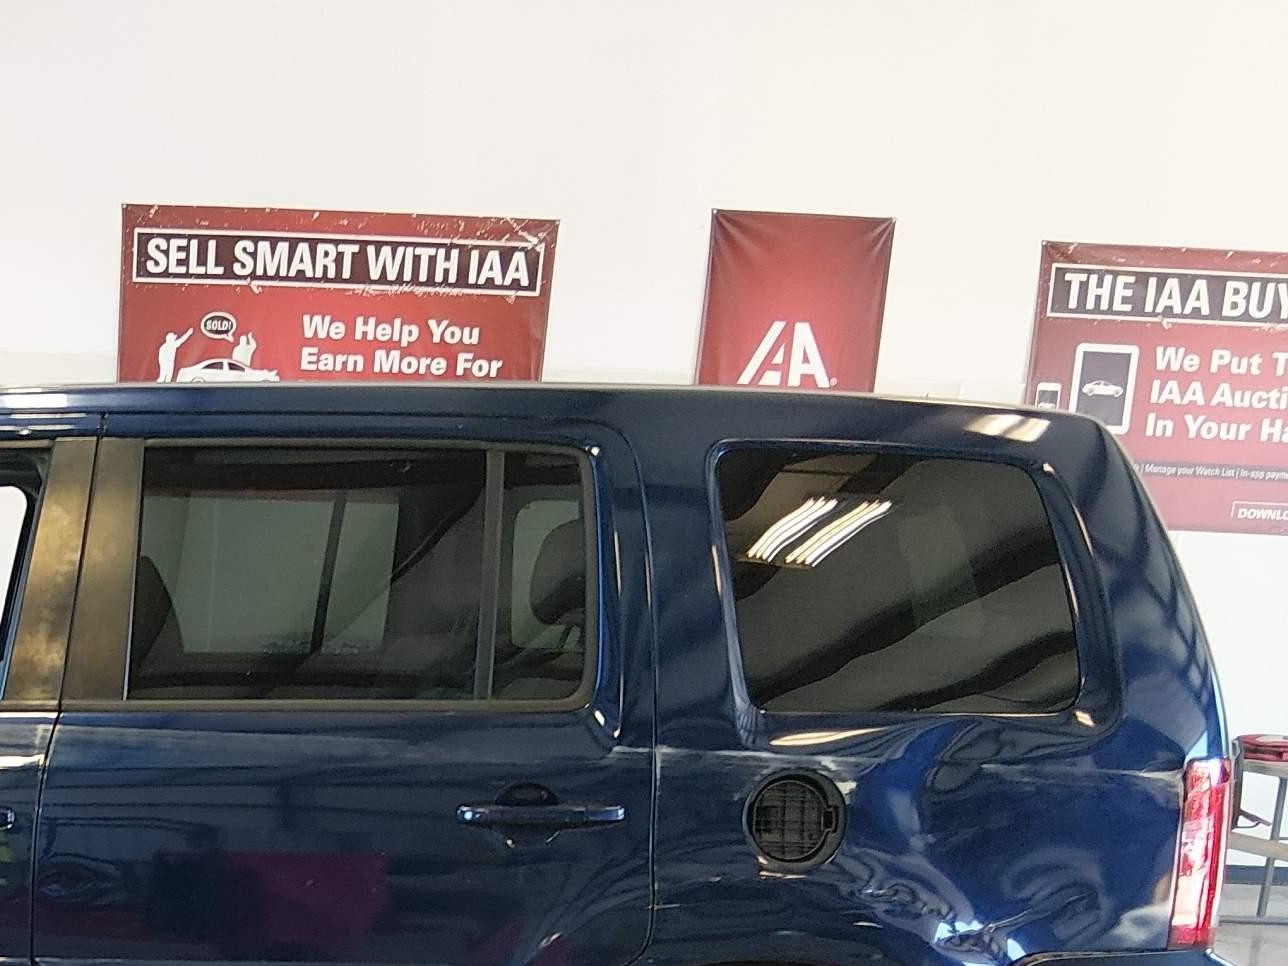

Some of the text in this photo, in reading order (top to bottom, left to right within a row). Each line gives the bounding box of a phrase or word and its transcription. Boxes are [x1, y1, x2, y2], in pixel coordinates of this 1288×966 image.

[146, 237, 530, 287] SELL SMART WITH IAA
[1065, 272, 1136, 312] THE
[1145, 277, 1210, 316] IAA
[206, 319, 232, 331] SOLD!
[302, 314, 480, 348] We Help You
[300, 346, 503, 378] Earn More For
[1154, 345, 1201, 373] We
[1209, 348, 1263, 376] Put
[1150, 378, 1205, 406] IAA
[1144, 411, 1174, 438] In
[1184, 414, 1252, 441] Your
[1144, 463, 1177, 477] Manage
[1177, 466, 1195, 477] your
[1196, 465, 1220, 477] Watch
[1221, 466, 1235, 478] List
